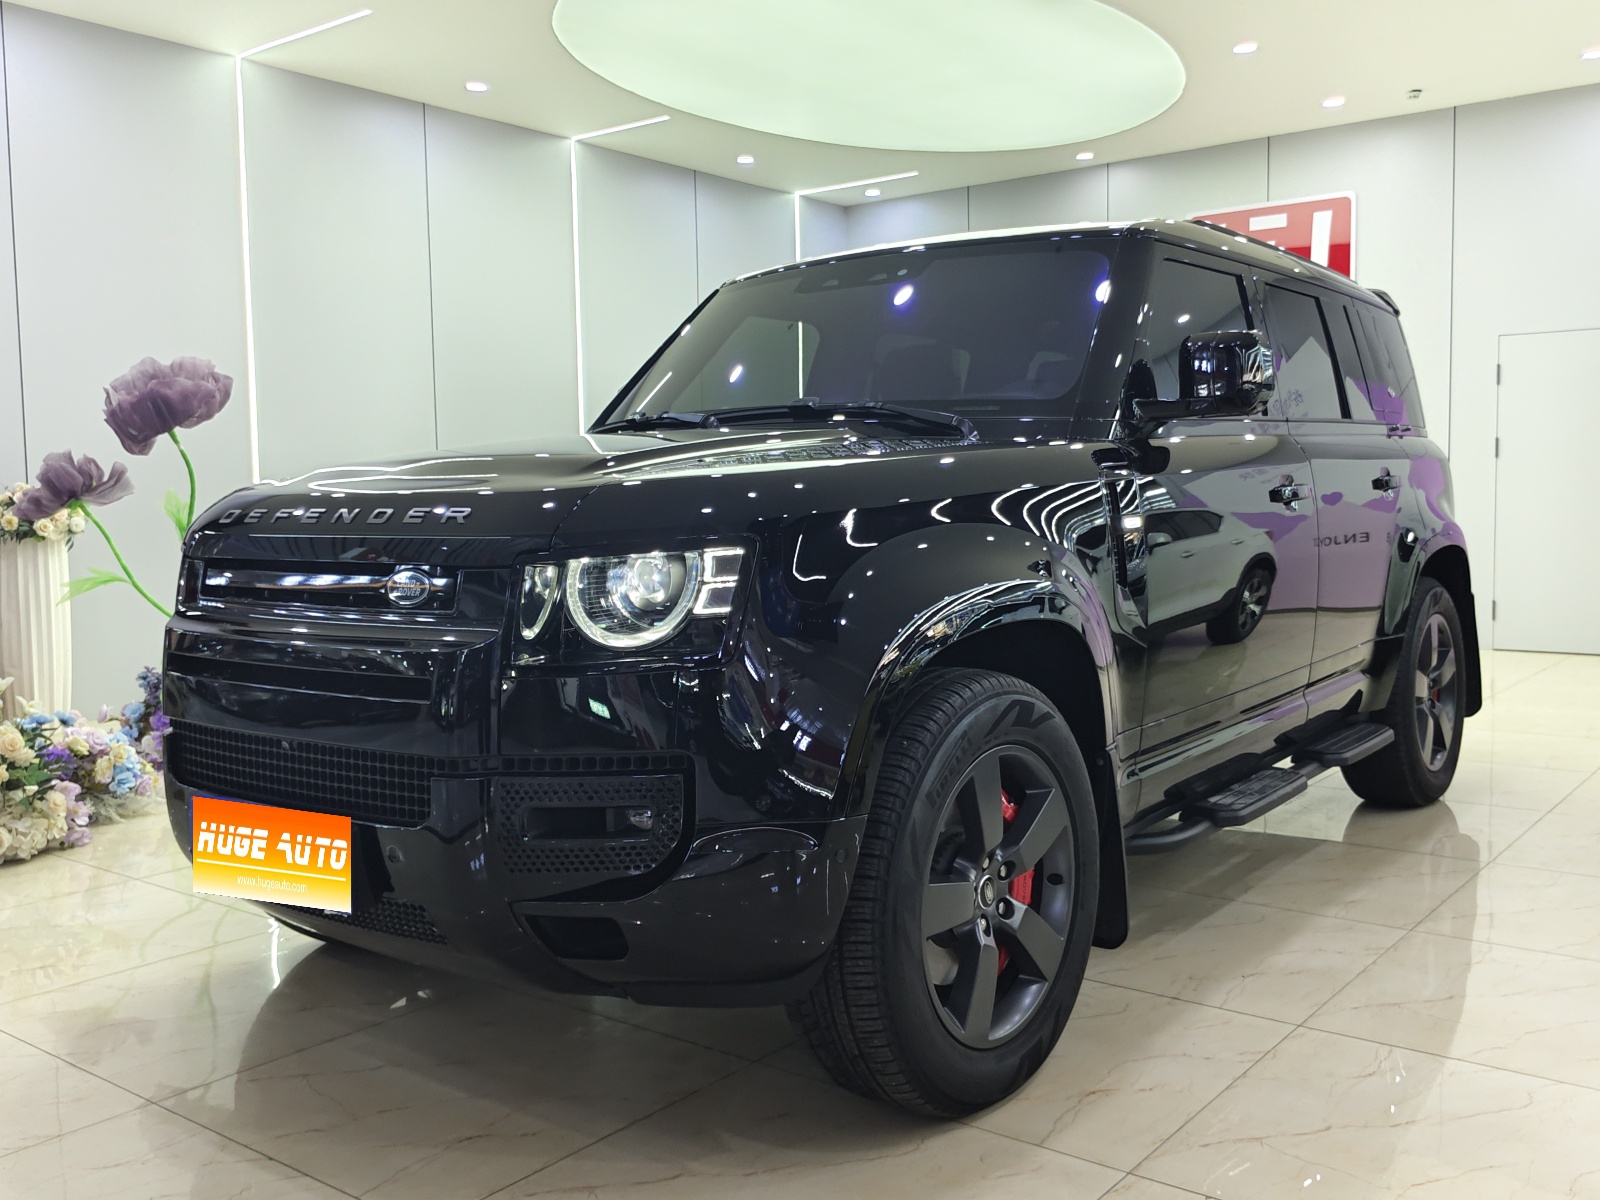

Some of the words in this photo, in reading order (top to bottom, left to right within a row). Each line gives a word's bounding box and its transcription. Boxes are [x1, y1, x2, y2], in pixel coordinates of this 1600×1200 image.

[219, 507, 472, 525] DEFENDER
[398, 588, 421, 597] ROVER
[925, 730, 972, 809] PIRELLI
